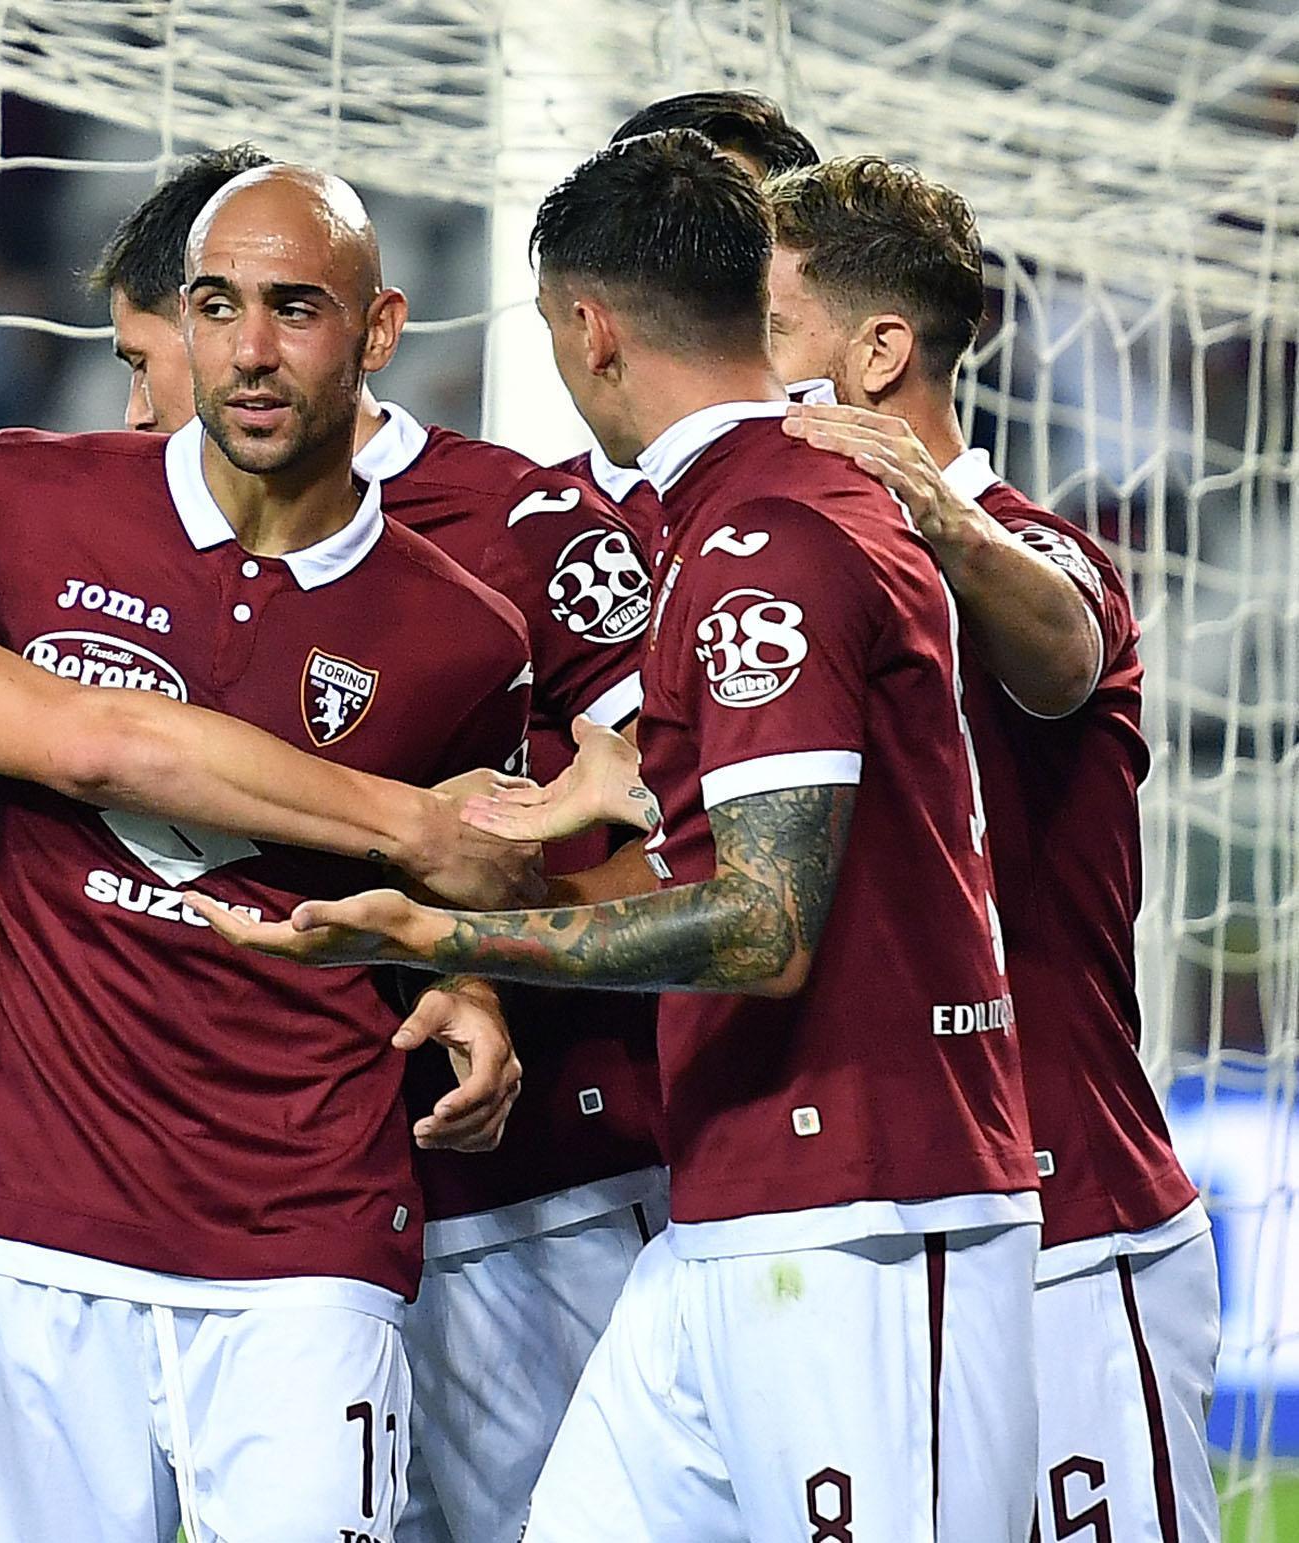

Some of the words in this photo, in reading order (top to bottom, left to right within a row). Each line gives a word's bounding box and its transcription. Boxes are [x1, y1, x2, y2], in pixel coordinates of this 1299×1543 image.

[58, 579, 171, 633] Joma
[697, 601, 809, 682] 38
[317, 660, 368, 691] TORINO
[343, 691, 363, 710] FC
